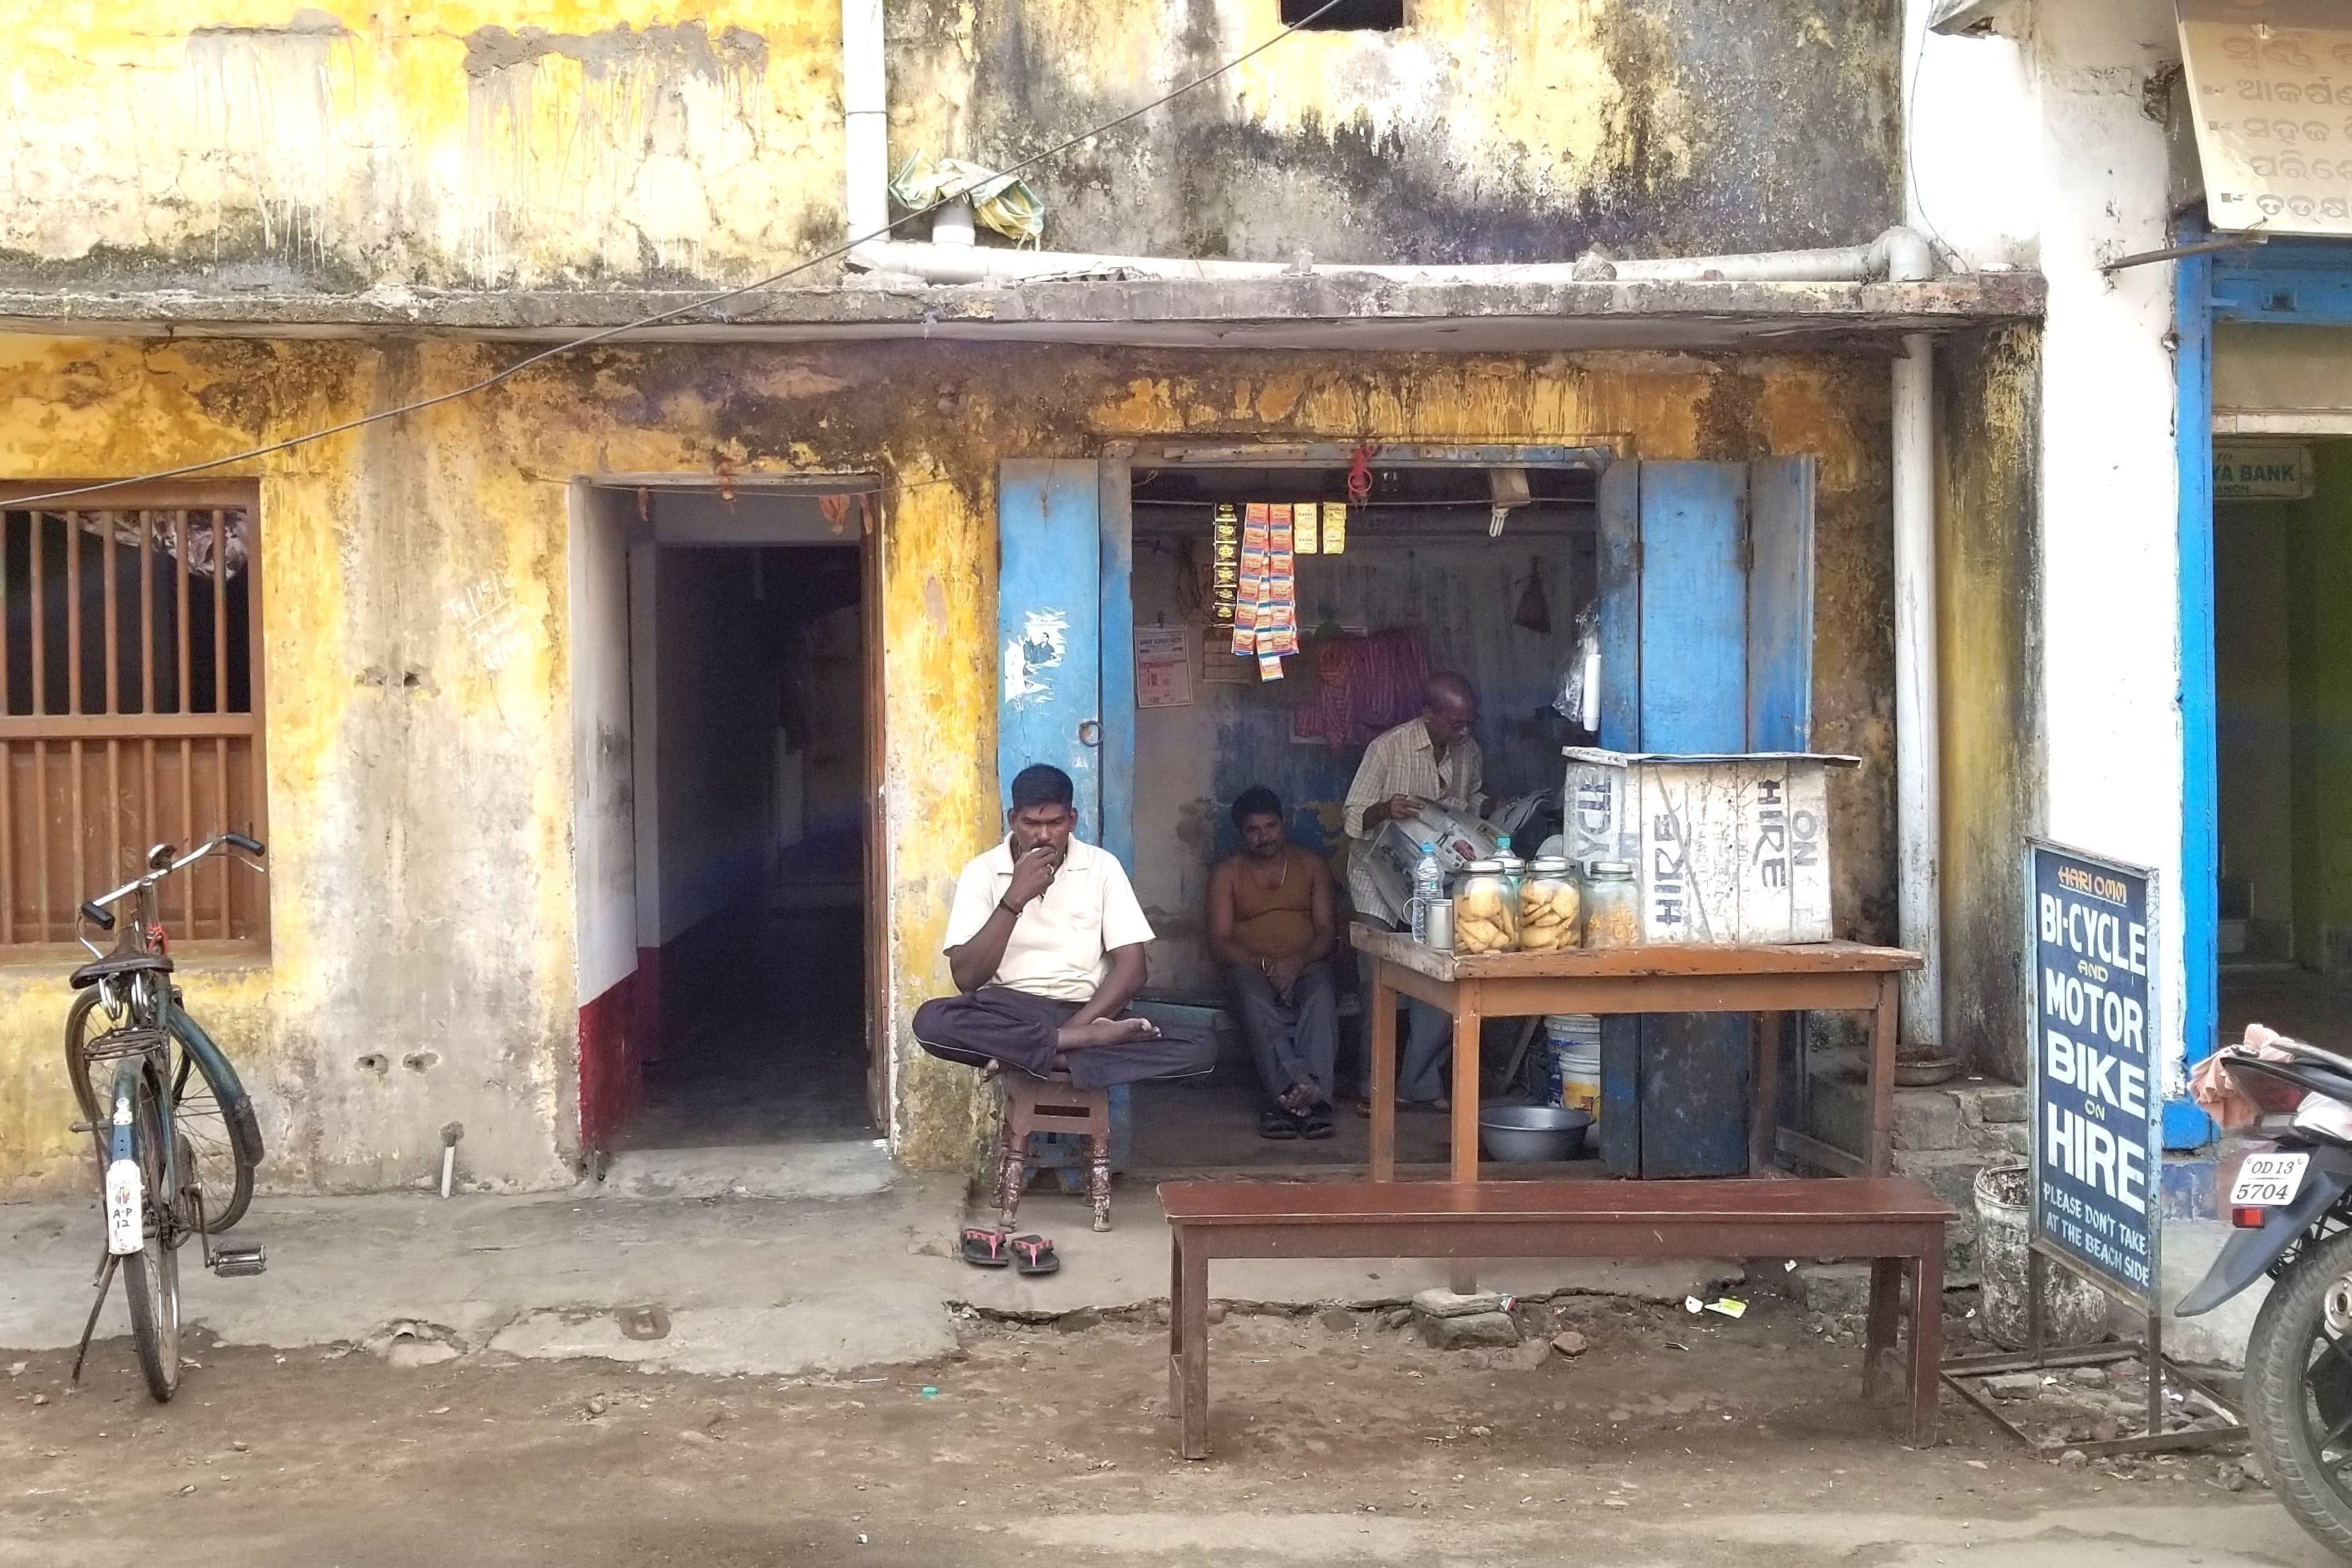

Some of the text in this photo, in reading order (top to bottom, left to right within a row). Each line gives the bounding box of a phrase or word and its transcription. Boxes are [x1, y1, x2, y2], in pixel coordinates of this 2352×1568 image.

[2240, 464, 2295, 482] BANK
[1654, 814, 1683, 925] HIRE
[1753, 779, 1786, 888] HIRE
[1791, 810, 1818, 866] ON
[2058, 866, 2127, 904] HARI OMM
[2040, 893, 2146, 977] BI-CYCLE
[2077, 959, 2109, 983] AND
[2045, 968, 2144, 1054] MOTOR
[2046, 1028, 2146, 1121] BIKE
[2085, 1099, 2106, 1121] ON
[2047, 1101, 2146, 1214] HIRE
[2236, 1183, 2289, 1200] 5704
[2251, 1161, 2294, 1174] OD 13
[2042, 1181, 2148, 1257] PLEASE DON'T TAKE
[2046, 1211, 2150, 1287] AT THE BEACH SIDE
